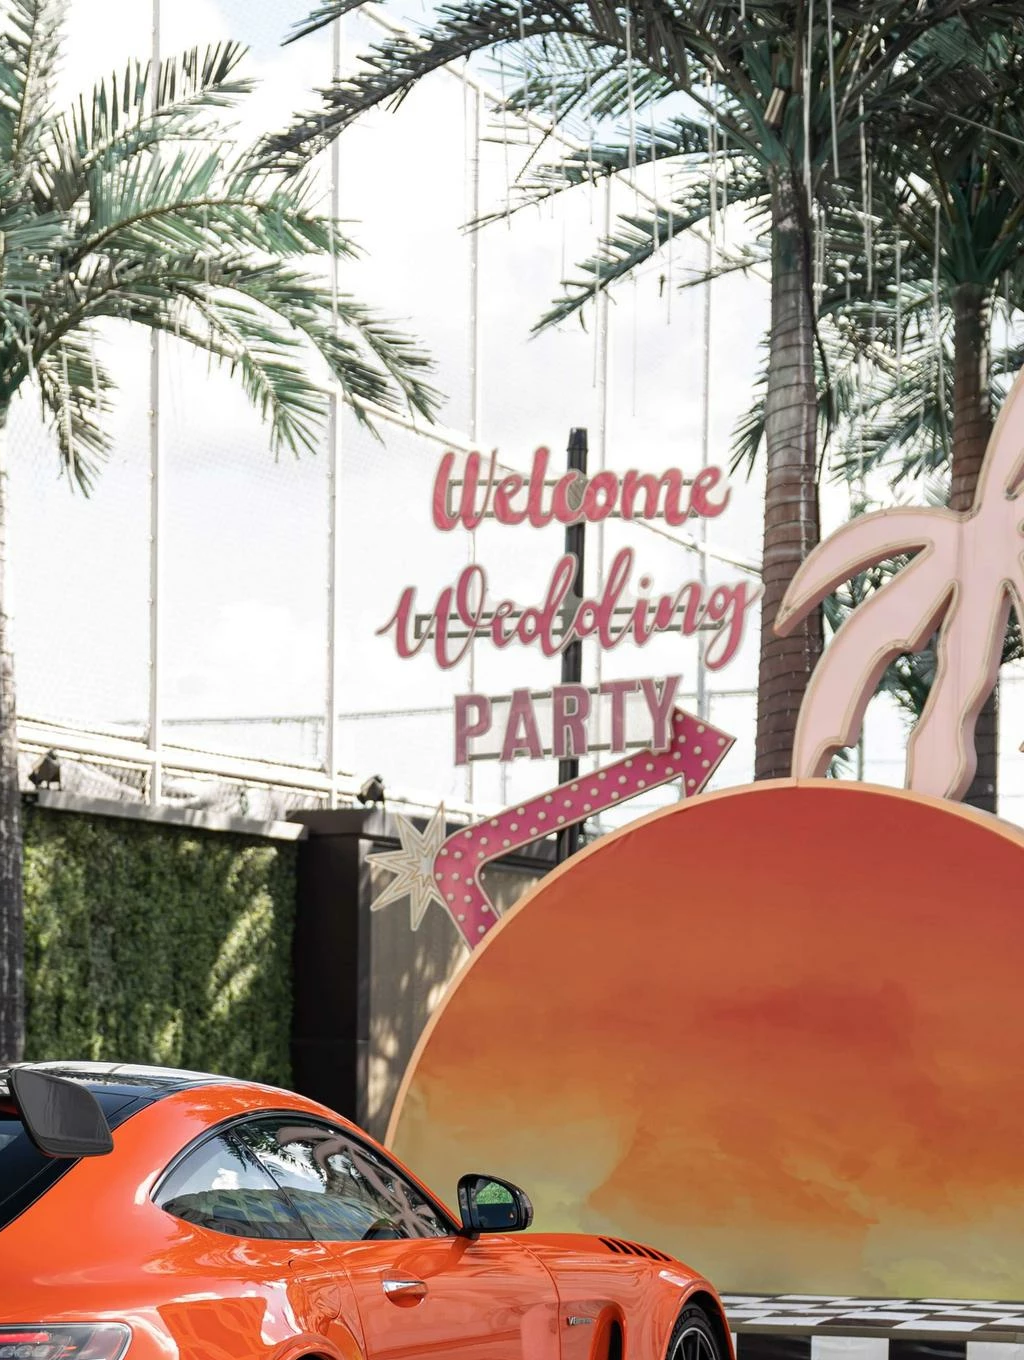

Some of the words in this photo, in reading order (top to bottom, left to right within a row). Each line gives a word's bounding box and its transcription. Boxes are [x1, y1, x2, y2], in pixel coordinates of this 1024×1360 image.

[432, 446, 731, 531] Welcome
[376, 546, 760, 671] Wedding
[454, 675, 683, 766] PARTY
